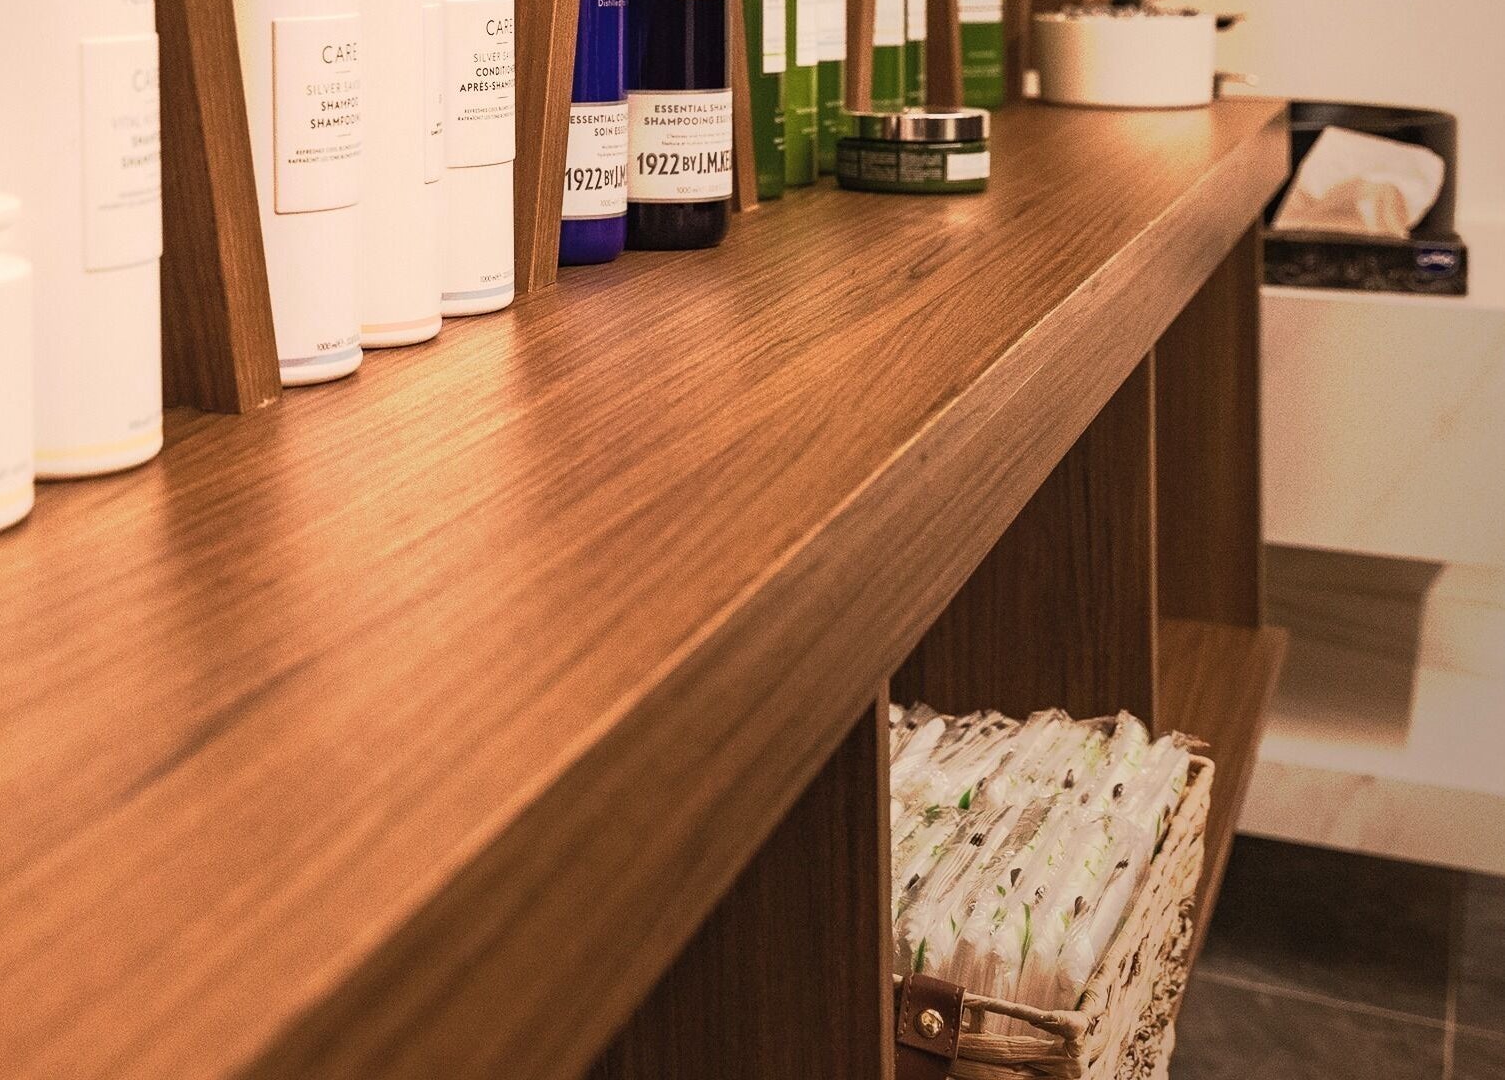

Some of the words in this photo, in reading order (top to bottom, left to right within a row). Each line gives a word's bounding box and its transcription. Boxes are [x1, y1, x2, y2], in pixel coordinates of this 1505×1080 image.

[485, 18, 513, 36] CARE
[322, 41, 357, 64] CARE
[473, 51, 501, 63] SILVER
[306, 81, 341, 96] SILVER
[654, 104, 707, 114] ESSENTIAL
[570, 113, 615, 125] ESSENTIAL
[644, 115, 714, 126] SHAMPOOING
[594, 126, 613, 137] SOIN
[637, 152, 680, 176] 1922
[682, 155, 697, 172] BY
[565, 167, 602, 191] 1922
[604, 168, 614, 187] BY
